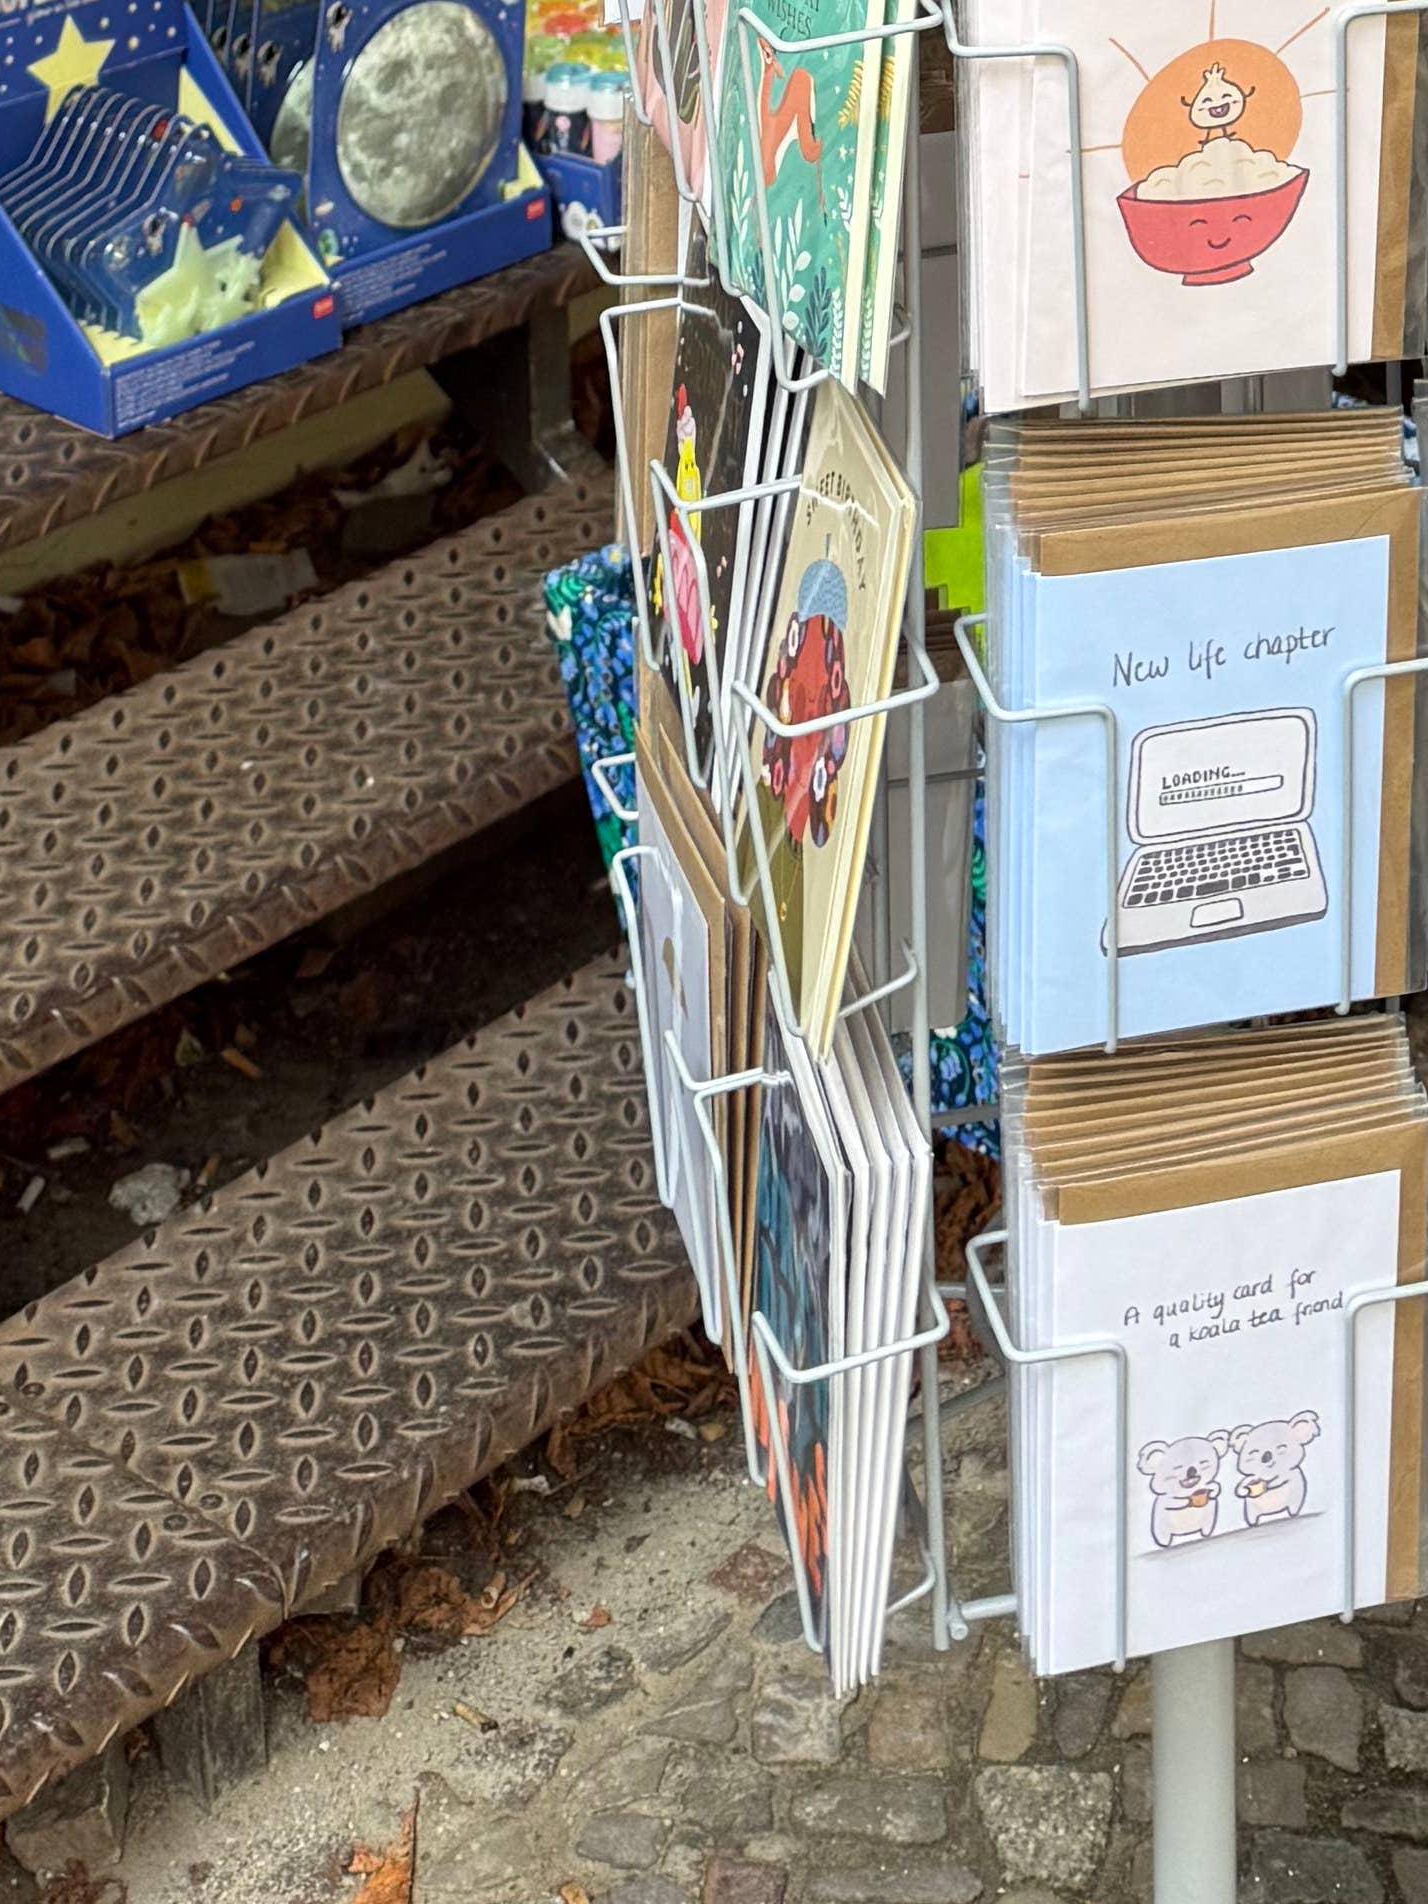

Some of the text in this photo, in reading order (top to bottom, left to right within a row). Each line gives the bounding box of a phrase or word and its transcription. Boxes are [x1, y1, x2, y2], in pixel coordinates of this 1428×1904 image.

[1122, 1268, 1317, 1330] A quality card for
